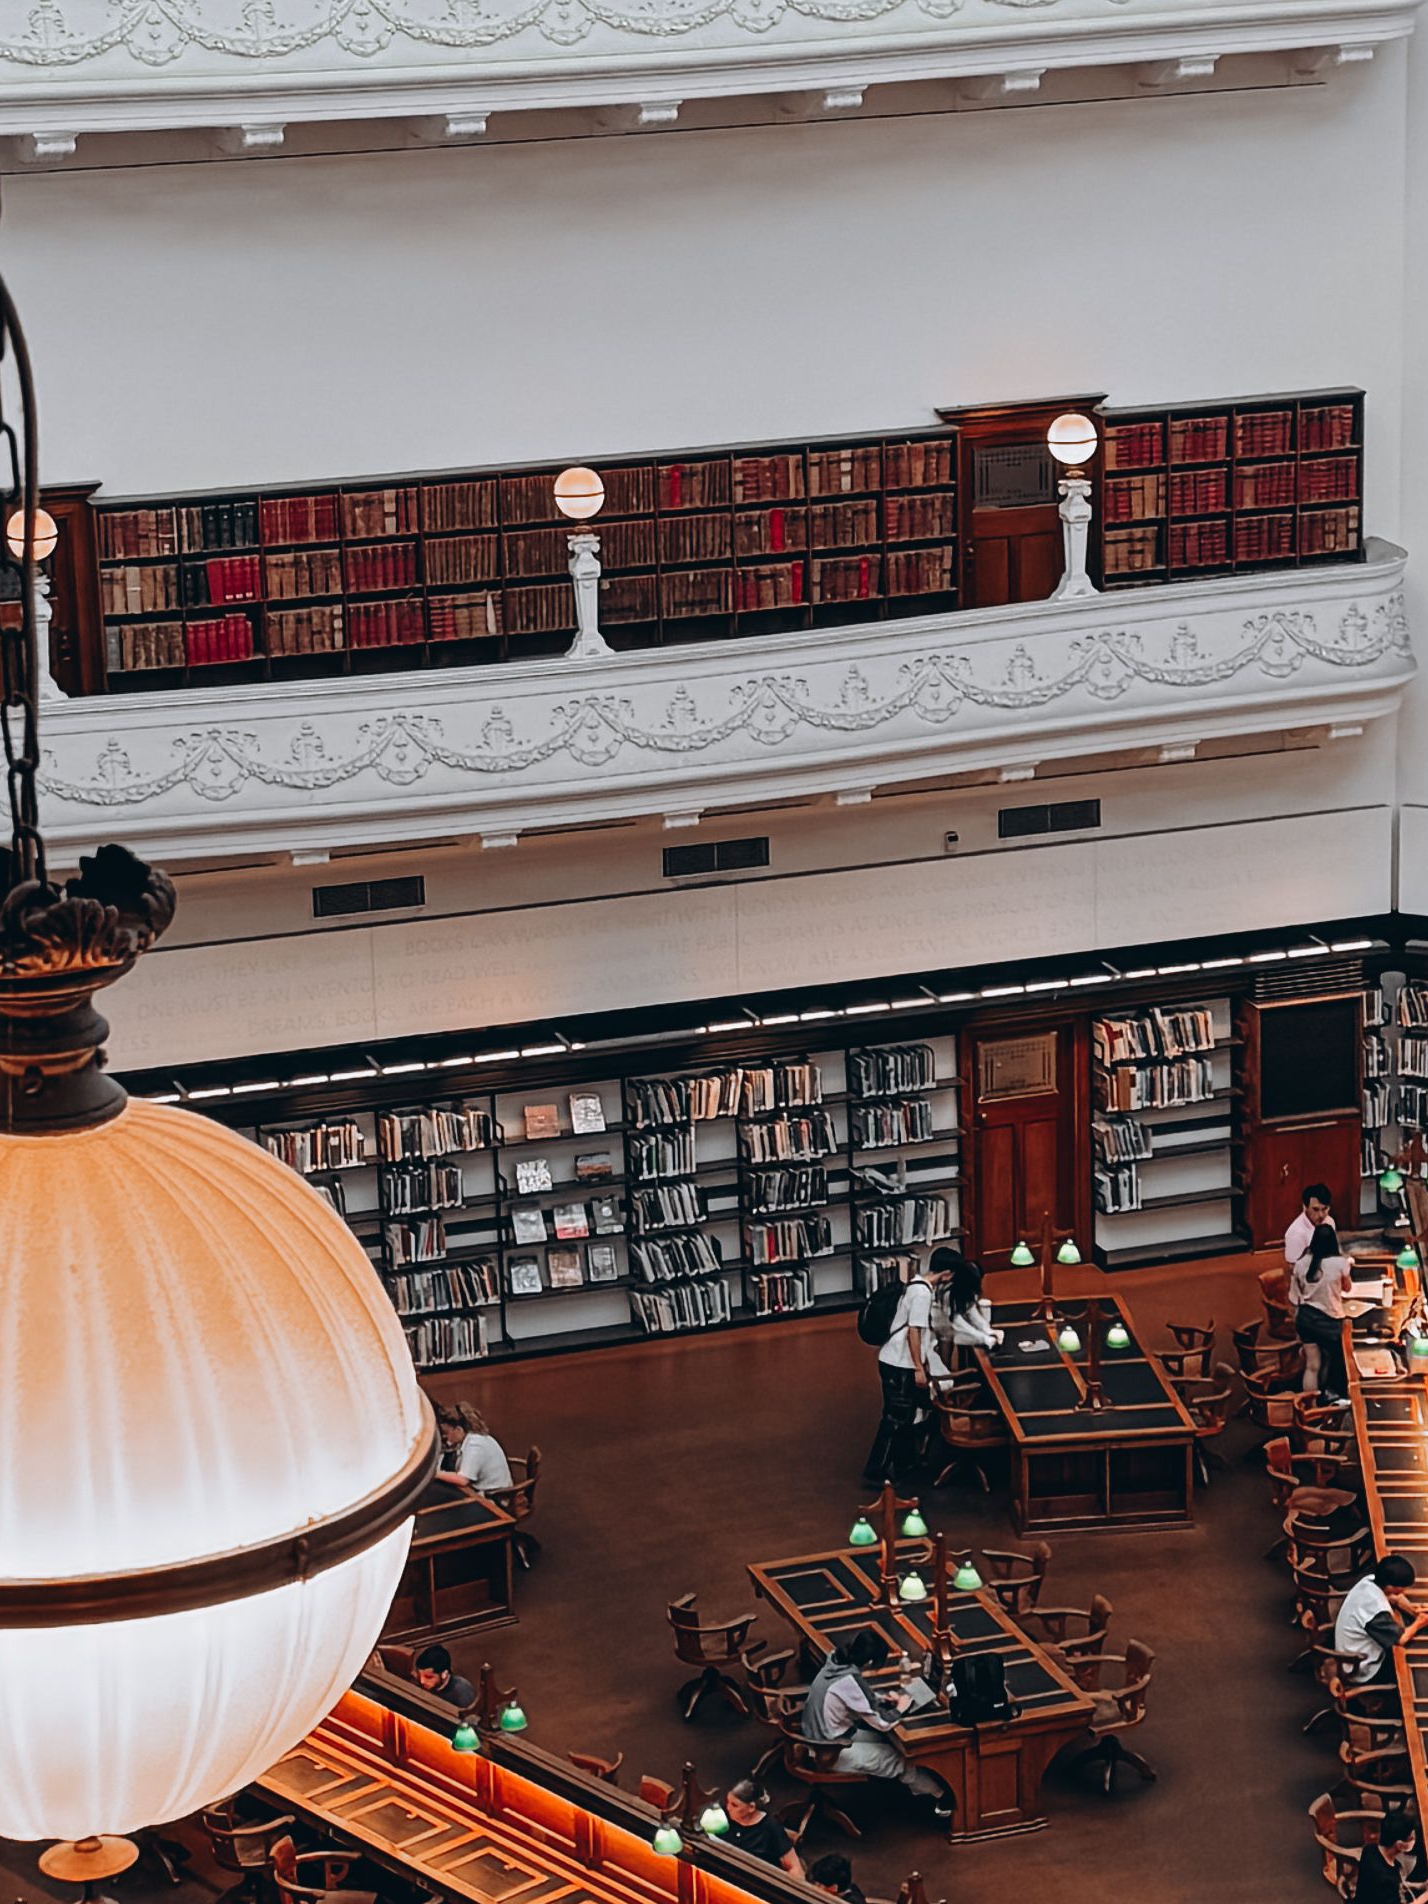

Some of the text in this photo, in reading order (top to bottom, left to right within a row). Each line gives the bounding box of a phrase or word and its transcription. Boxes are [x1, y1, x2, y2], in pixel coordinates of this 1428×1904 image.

[404, 934, 463, 956] BOOKS
[214, 959, 259, 979] THEY
[137, 999, 175, 1018] ONE
[181, 992, 230, 1013] MUST
[421, 963, 466, 984] READ
[473, 957, 519, 978] WELL
